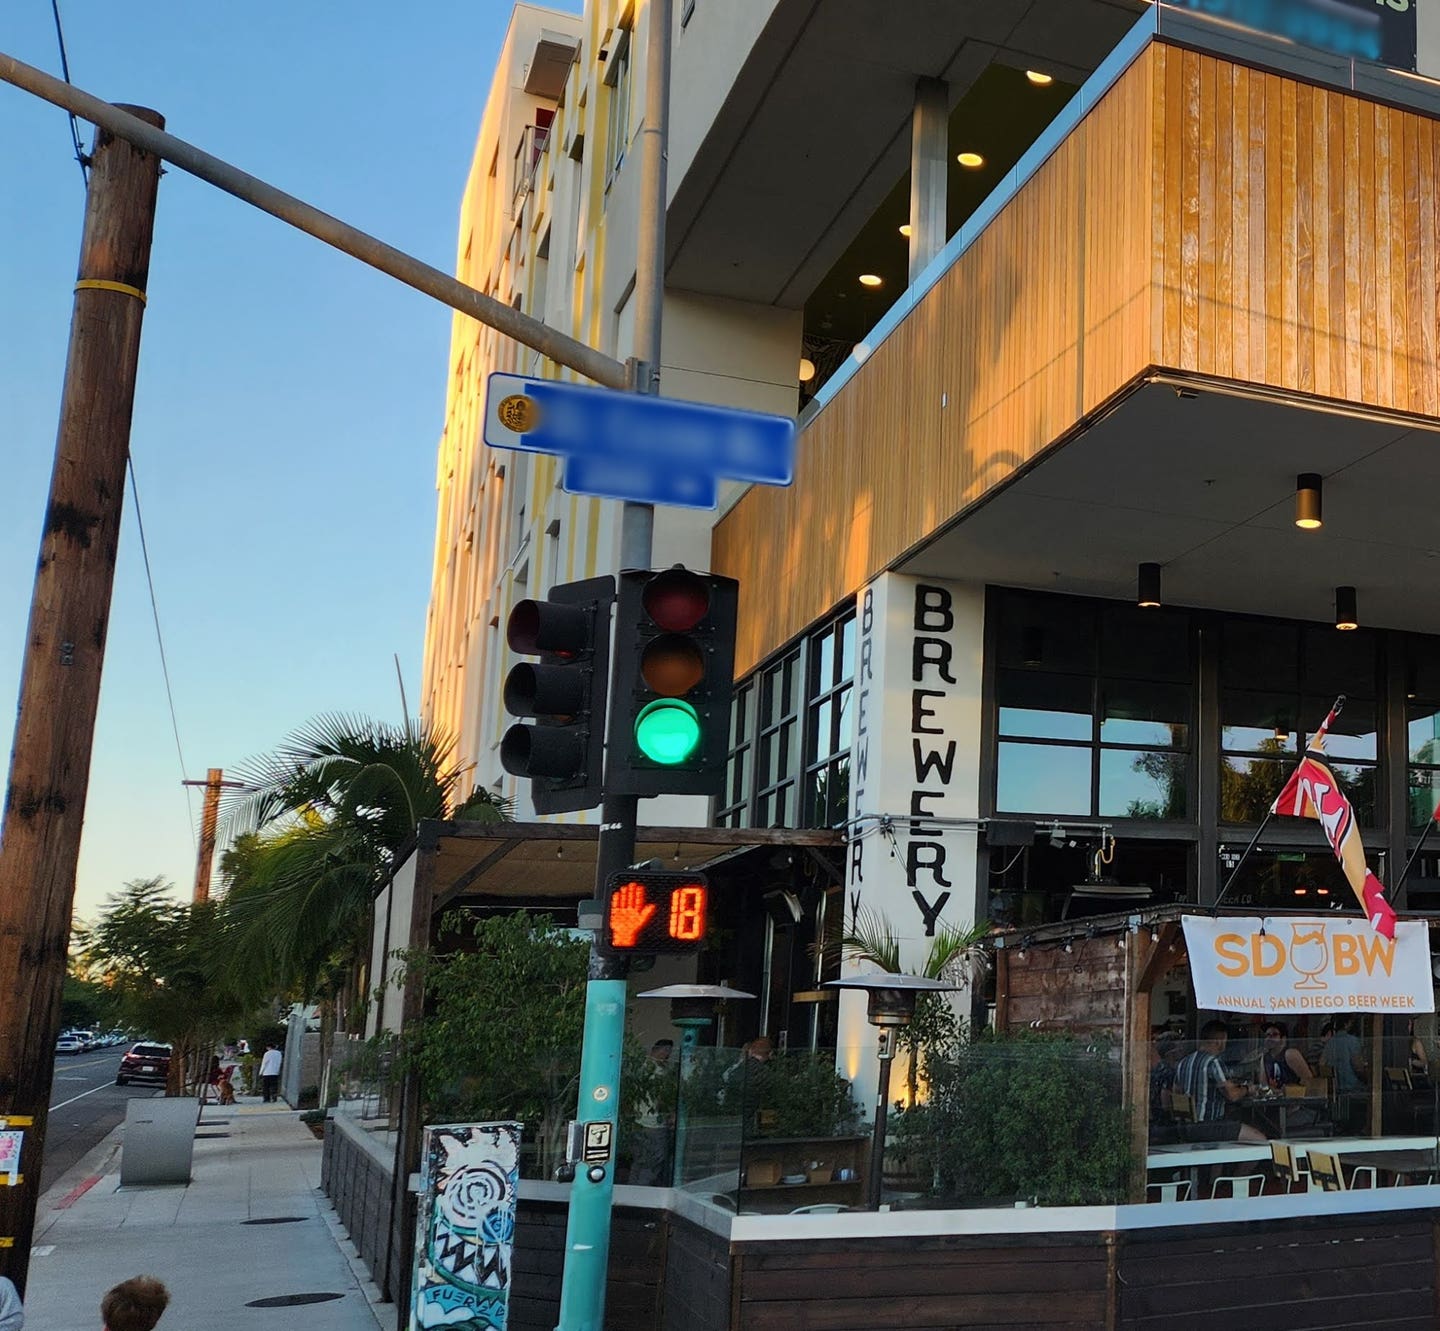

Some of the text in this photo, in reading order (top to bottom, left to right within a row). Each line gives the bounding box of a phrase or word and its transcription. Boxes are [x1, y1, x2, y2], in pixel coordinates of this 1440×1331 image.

[851, 588, 874, 936] BREWERY
[907, 583, 957, 937] BREWERY
[669, 886, 706, 940] 18
[1214, 932, 1397, 978] SD BW
[1217, 995, 1415, 1010] ANNUAL SAN DIEGO BEER WEEK
